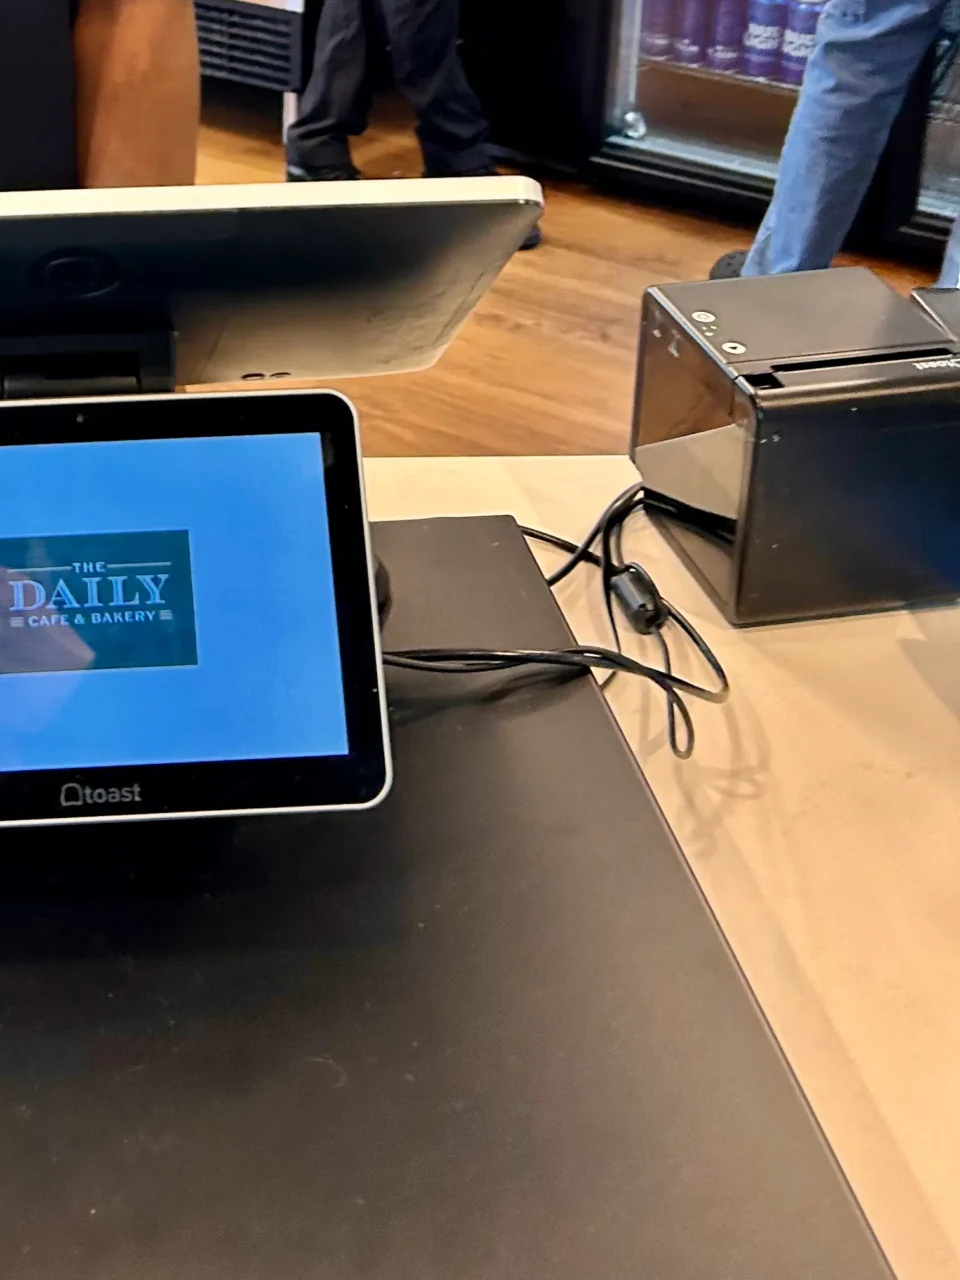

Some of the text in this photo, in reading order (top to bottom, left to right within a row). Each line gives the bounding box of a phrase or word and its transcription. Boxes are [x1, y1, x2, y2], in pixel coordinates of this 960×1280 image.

[72, 562, 105, 573] THE
[8, 574, 169, 611] DAILY
[28, 611, 155, 627] CAFE & BAKERY
[84, 783, 142, 803] toast
